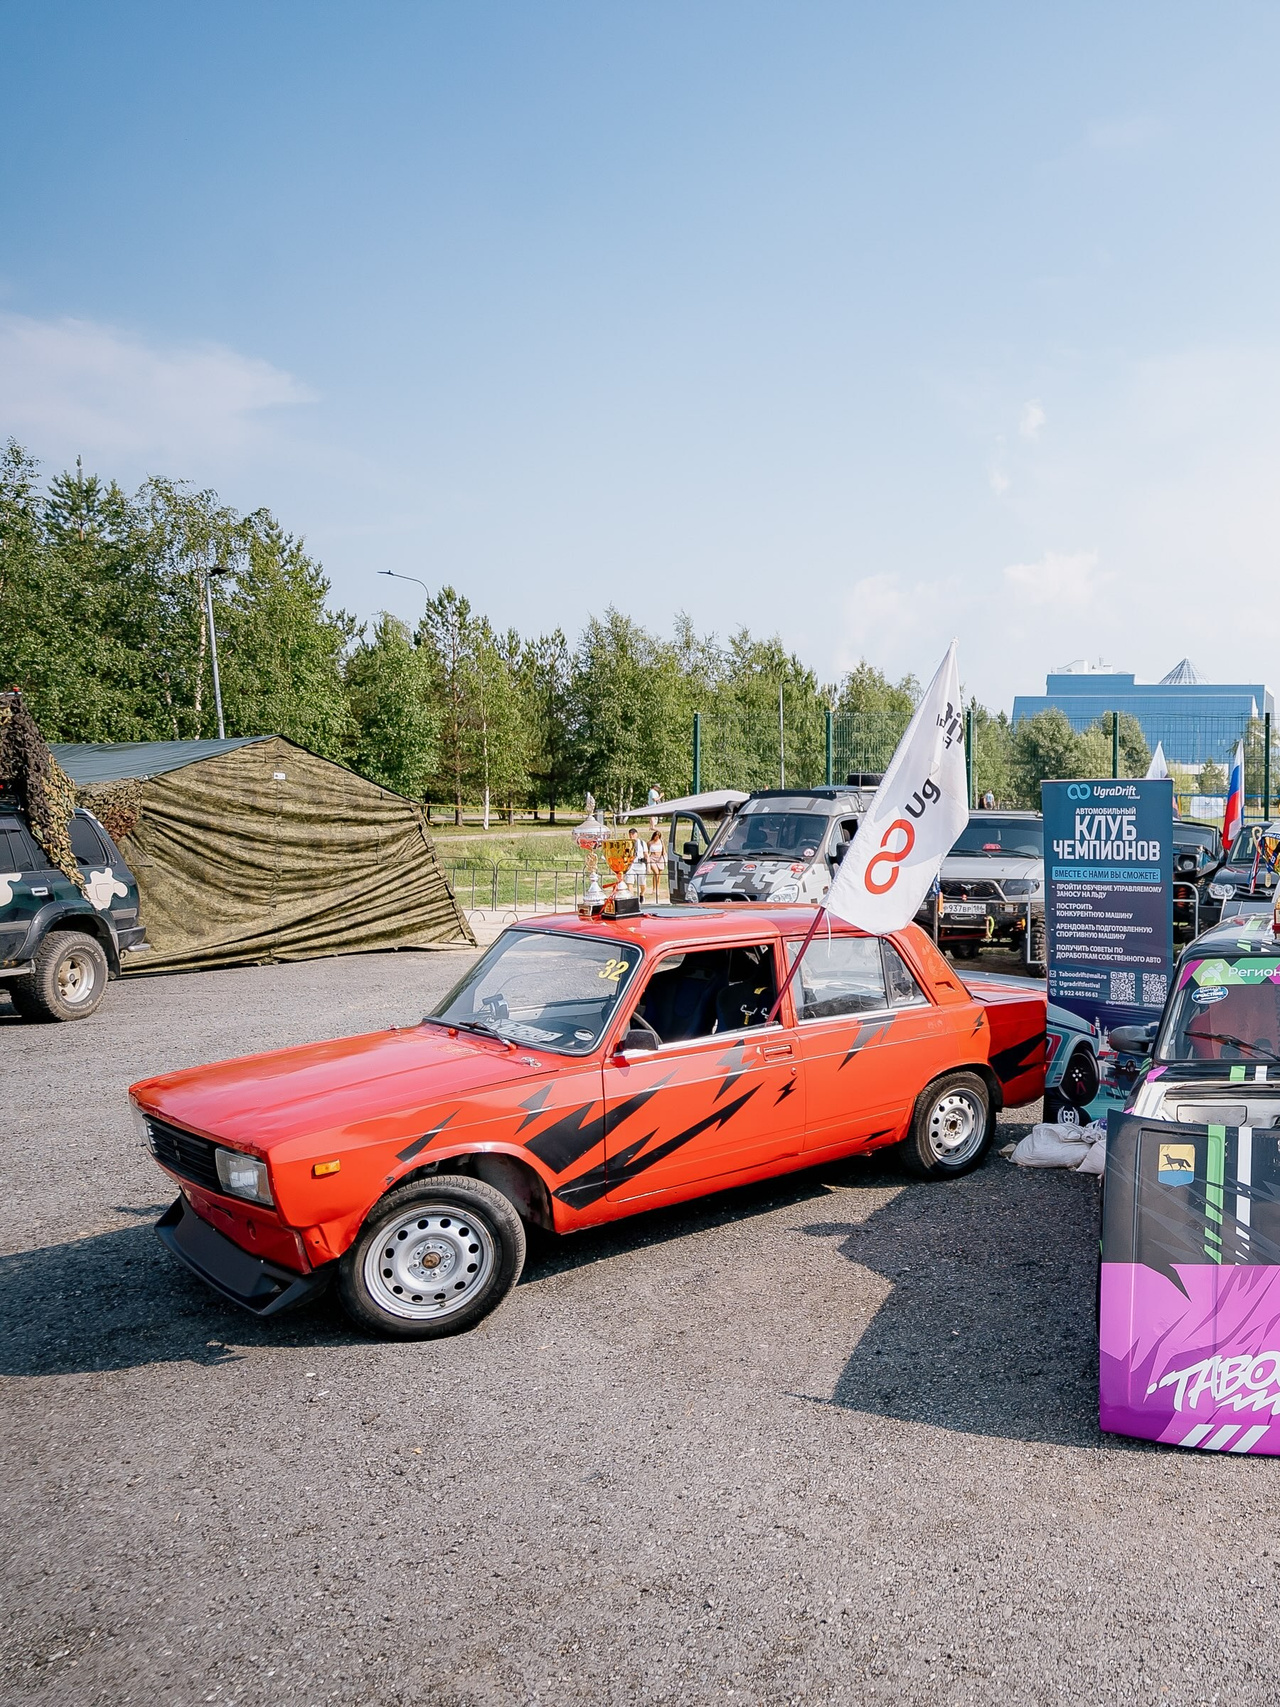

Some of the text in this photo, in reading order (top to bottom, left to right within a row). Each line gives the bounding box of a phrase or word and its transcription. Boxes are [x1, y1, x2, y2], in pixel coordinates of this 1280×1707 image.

[1093, 785, 1136, 798] UgraDrift
[1075, 807, 1136, 815] АВТОМОБИЛЬНЫЙ
[1075, 815, 1137, 840] КЛУБ
[1053, 840, 1161, 861] ЧЕМПИОНОВ
[1054, 870, 1159, 880] ВМЕСТЕ С НАМИ ВЫ СМОЖЕТЕ:
[1056, 883, 1163, 893] ПРОЙТИ ОБУЧЕНИЕ УПРАВЛЯЕМОМУ
[1056, 890, 1081, 898] ЗАНОСУ
[1091, 891, 1107, 899] ЛЬДУ
[1056, 902, 1093, 910] ПОСТРОИТЬ
[1056, 910, 1133, 920] КОНКУРЕНТНУЮ МАШИНУ
[1056, 923, 1153, 934] АРЕНДОВАТЬ ПОДГОТОВЛЕННУЮ
[1055, 930, 1126, 940] СПОРТИВНУЮ МАШИНУ
[1056, 944, 1124, 954] ПОЛУЧИТЬ СОВЕТЫ ПО
[1056, 951, 1162, 964] ДОРАБОТКАМ СОБСТВЕННОГО АВТО
[598, 958, 630, 982] 32
